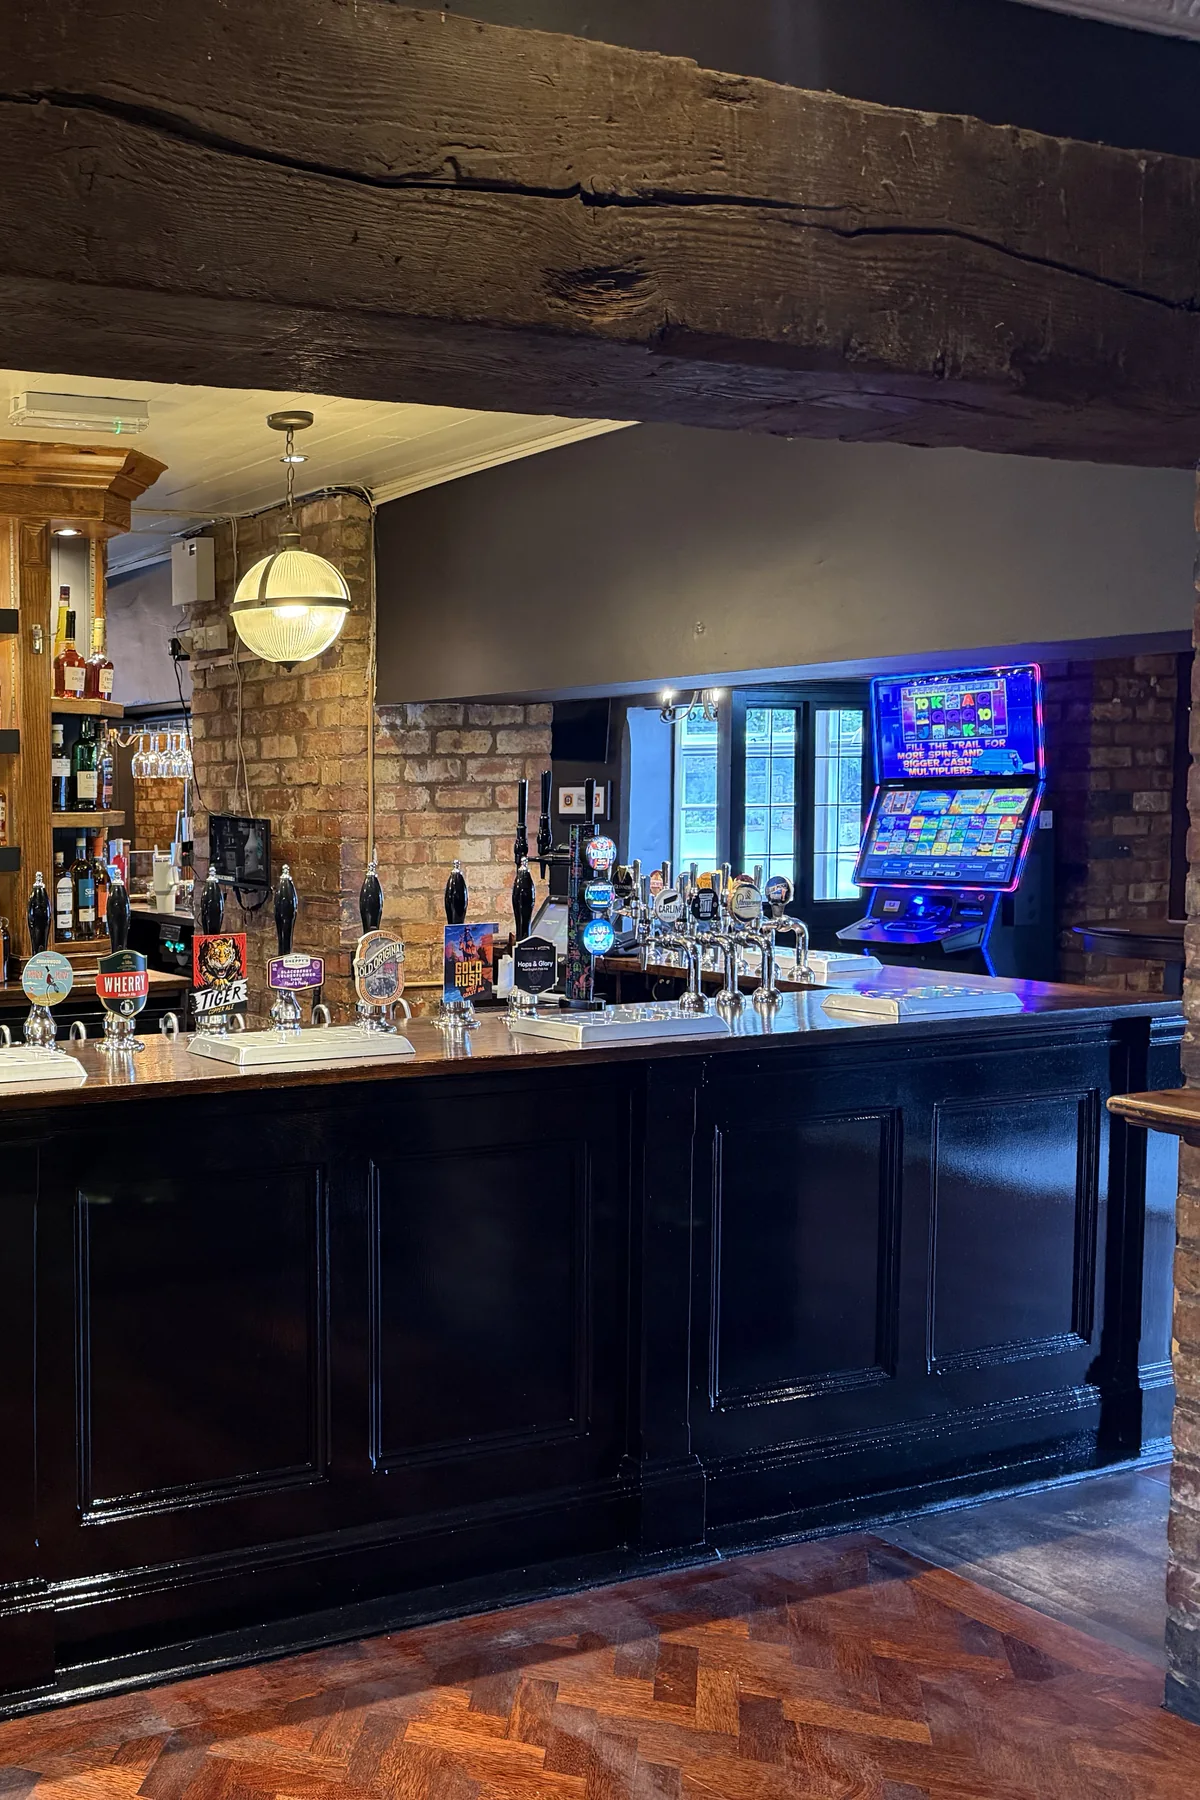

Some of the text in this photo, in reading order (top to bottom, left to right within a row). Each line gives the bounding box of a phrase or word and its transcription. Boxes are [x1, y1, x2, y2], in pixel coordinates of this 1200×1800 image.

[916, 698, 929, 710] 10
[931, 696, 944, 709] K
[962, 694, 974, 707] A
[932, 708, 991, 724] Q Q Q 10
[962, 724, 975, 737] K
[906, 739, 1006, 751] FILL THE TRAIL FOR
[897, 752, 925, 760] MORE
[962, 748, 984, 757] AND
[903, 758, 972, 768] BIGGER CASH
[908, 766, 973, 775] MULTIPLIERS
[359, 943, 404, 977] OLD ORIGINAL
[538, 960, 553, 968] Glory
[455, 961, 482, 974] GOLD
[104, 974, 145, 993] WHERRY
[455, 973, 482, 987] RUSH
[201, 986, 241, 1009] TIGER
